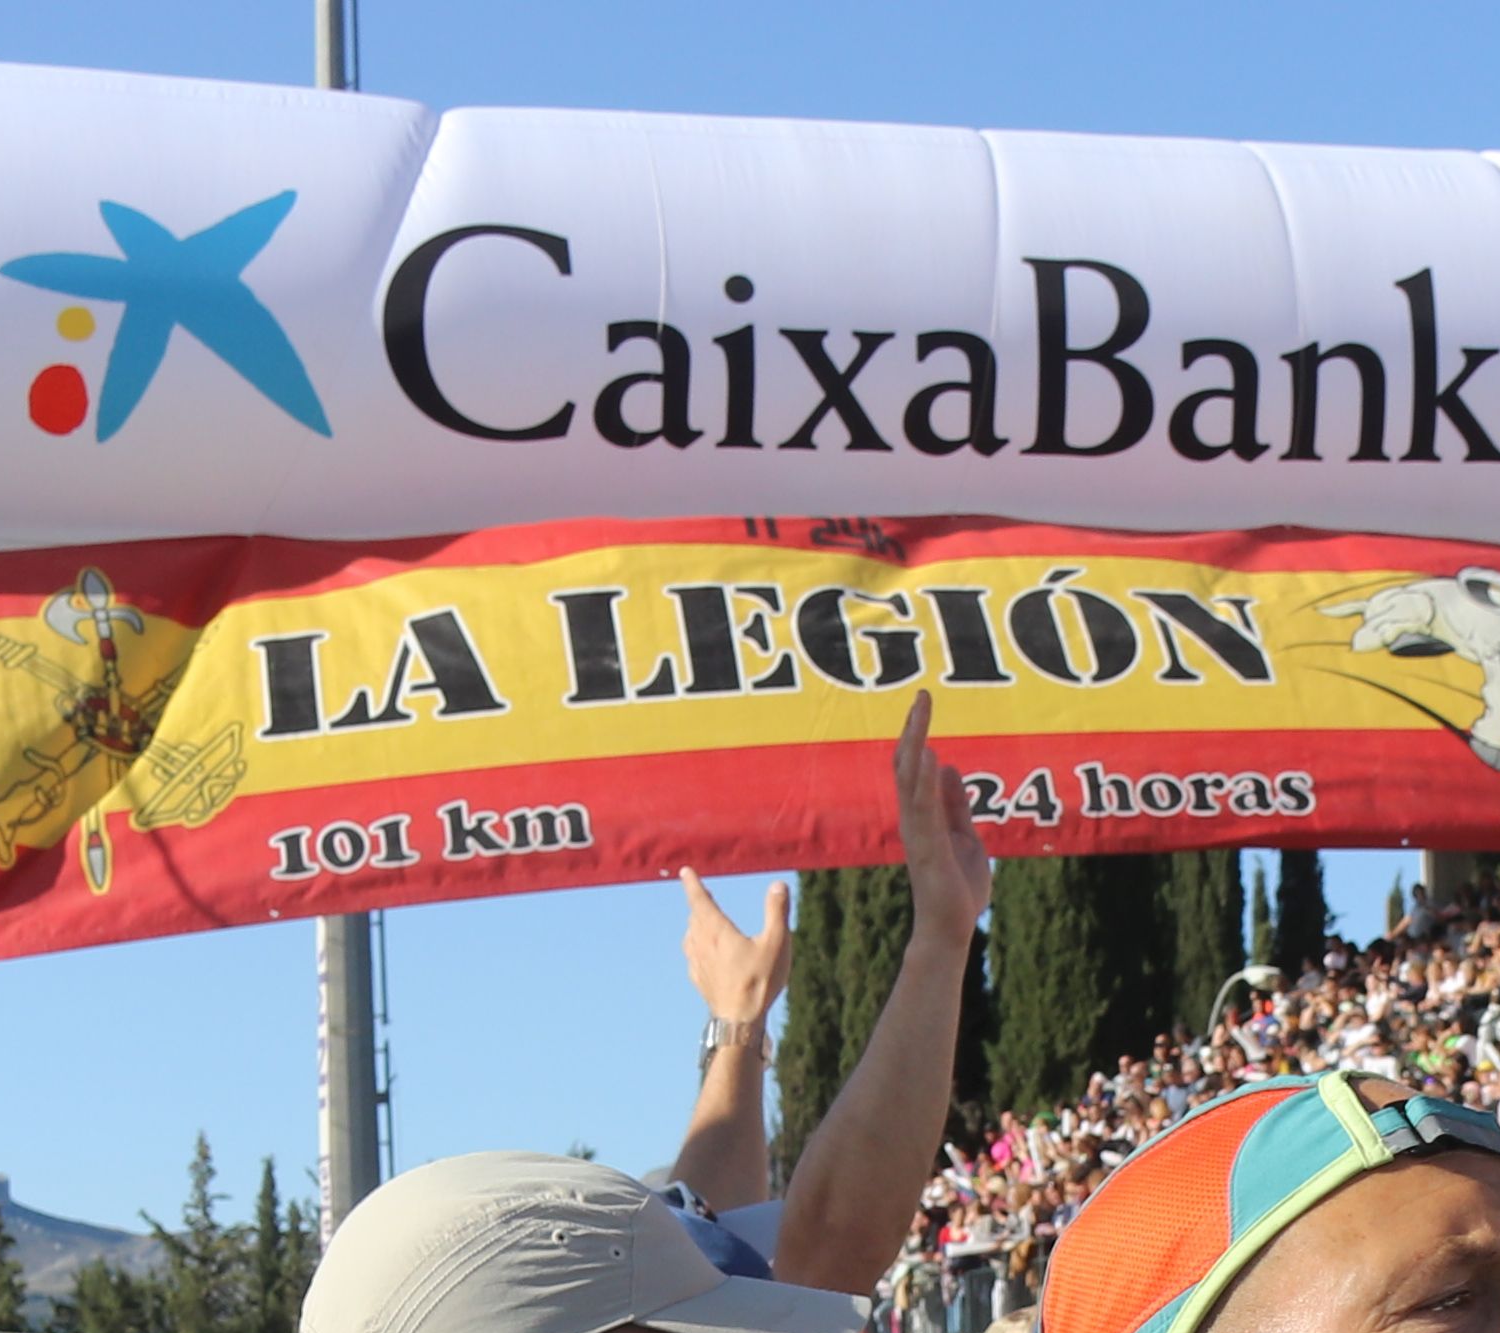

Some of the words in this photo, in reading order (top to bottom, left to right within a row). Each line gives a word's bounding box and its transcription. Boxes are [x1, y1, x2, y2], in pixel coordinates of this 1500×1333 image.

[255, 605, 508, 742] LA
[564, 565, 1278, 708] LEGIÓN
[962, 767, 1062, 826] 24
[1076, 760, 1316, 817] horas
[268, 813, 420, 881] 101
[437, 798, 594, 861] km
